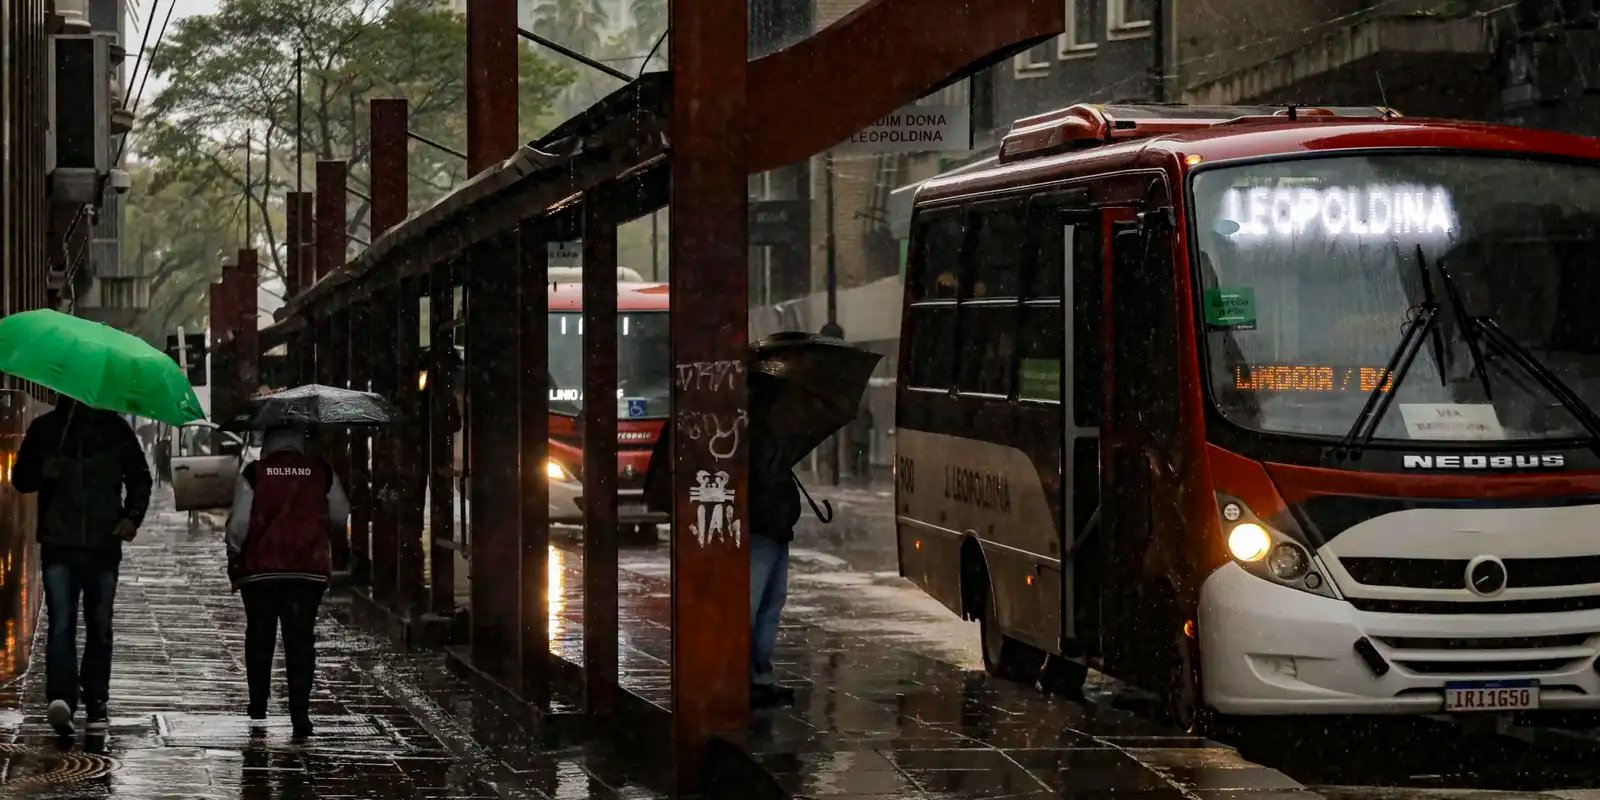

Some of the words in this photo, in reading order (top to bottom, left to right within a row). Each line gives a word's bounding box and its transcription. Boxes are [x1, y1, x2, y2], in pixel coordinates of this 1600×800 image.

[873, 115, 901, 127] DIM
[906, 114, 946, 126] DONA
[851, 130, 943, 143] LEOPOLDINA
[1227, 188, 1452, 235] LEOPOLDINA
[1403, 455, 1564, 469] NEOBUS
[266, 467, 311, 476] ROLHANO
[1454, 689, 1530, 708] IRI1G50
